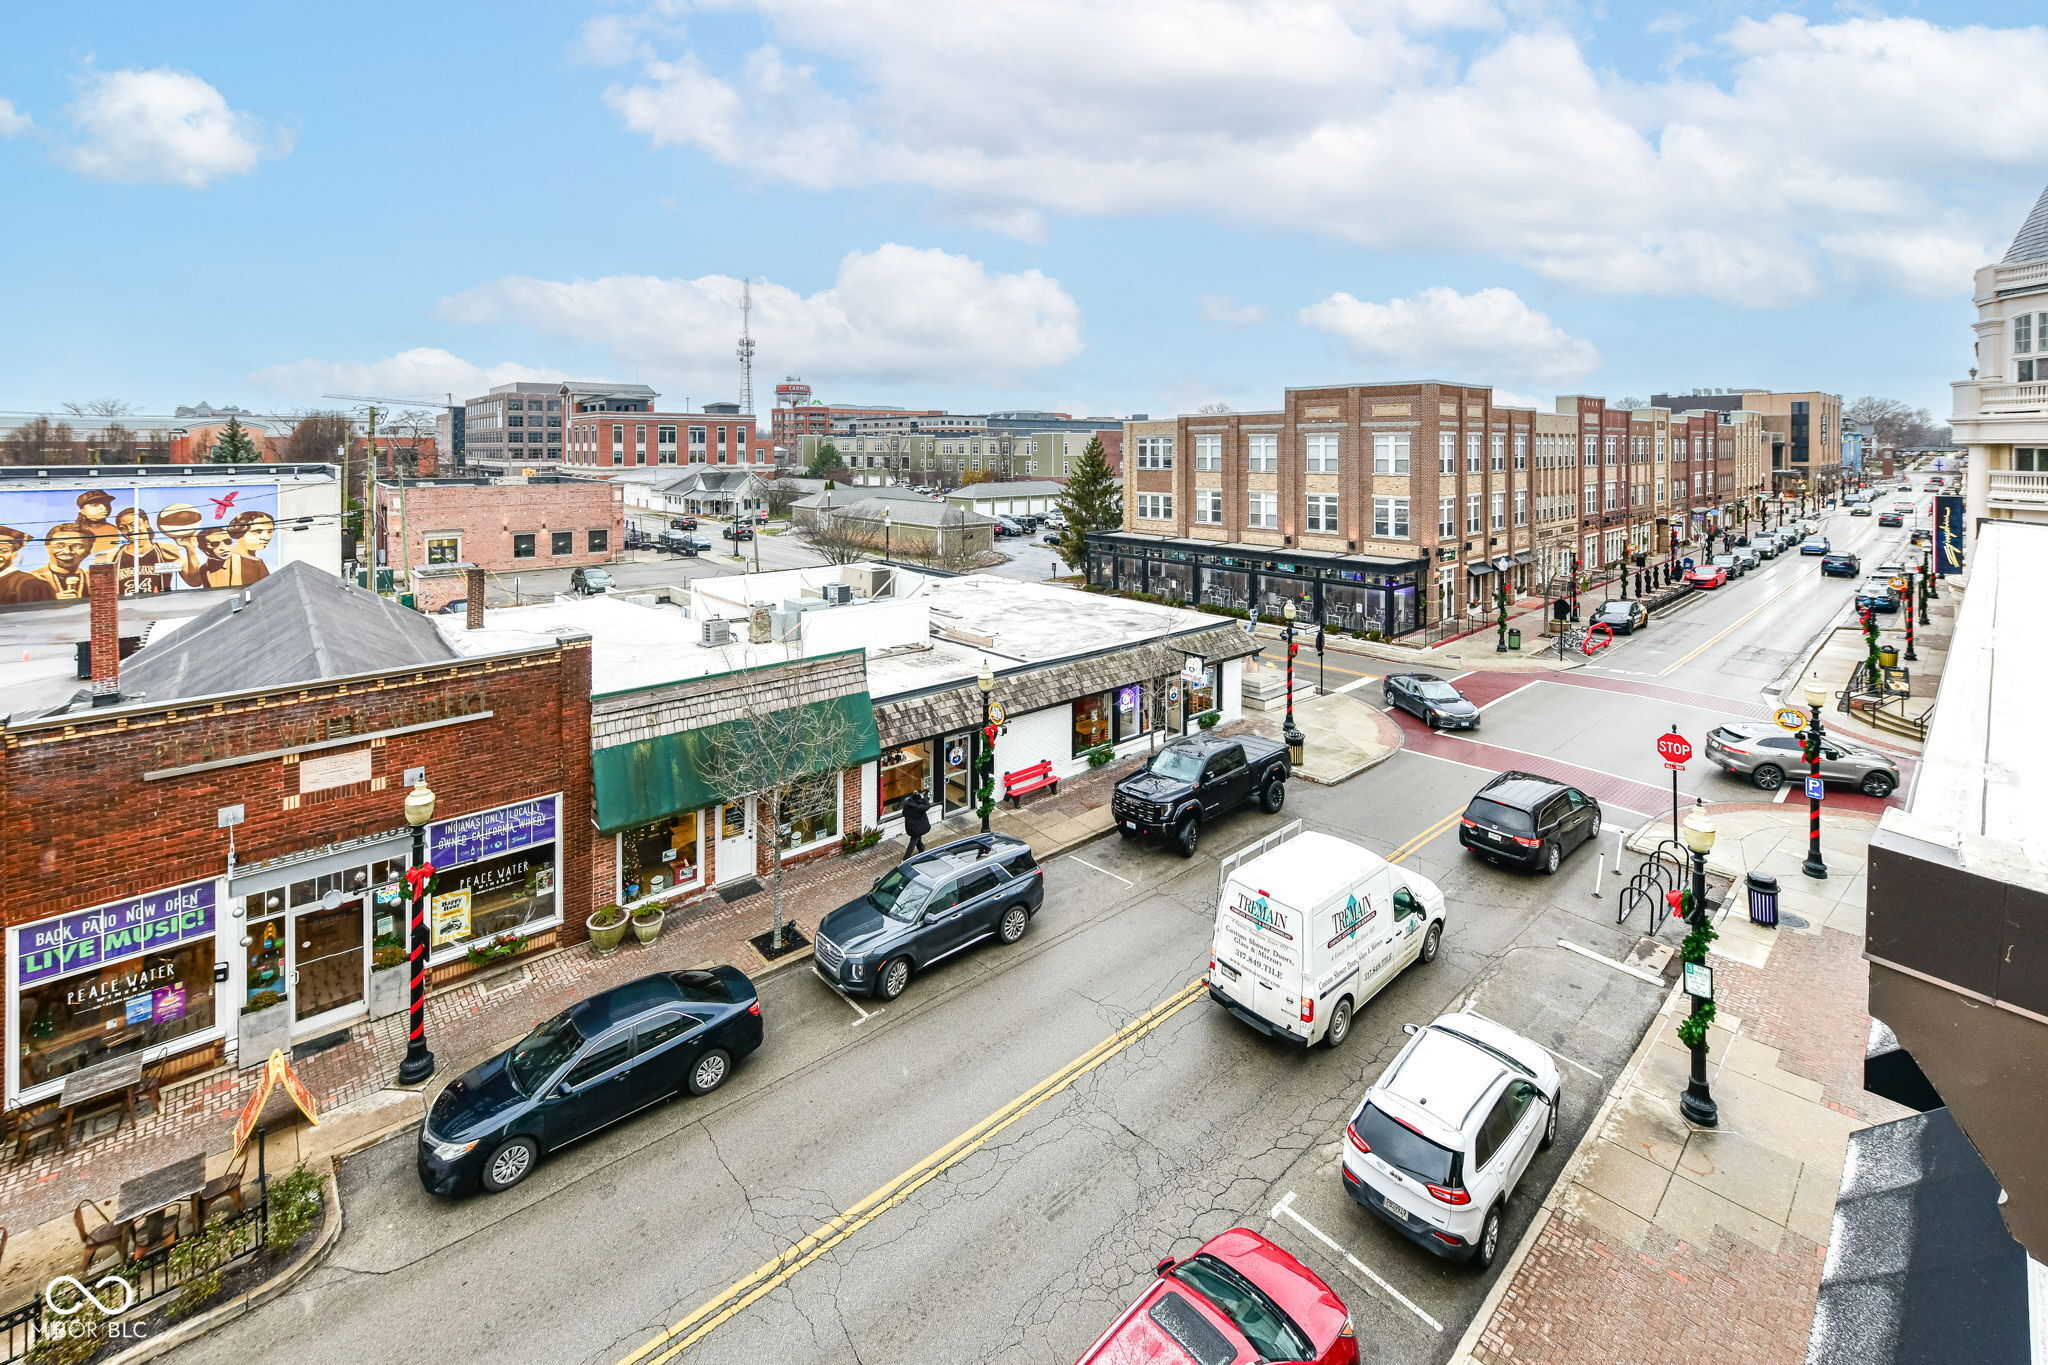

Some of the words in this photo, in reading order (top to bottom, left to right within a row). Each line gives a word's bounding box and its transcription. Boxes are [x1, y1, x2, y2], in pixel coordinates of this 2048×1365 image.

[1659, 740, 1690, 756] STOP
[1809, 779, 1820, 791] P
[445, 815, 480, 835] INDIANA'S
[485, 811, 505, 825] ONLY
[509, 801, 543, 821] LOCALLY
[438, 834, 467, 850] OWNED
[471, 823, 517, 841] CALIFORNIA
[459, 869, 493, 890] PEACE
[497, 861, 529, 879] WATER
[35, 924, 79, 947] BACK
[82, 914, 117, 935] PATIO
[126, 904, 156, 924] NOW
[165, 888, 202, 913] OPEN
[1237, 892, 1288, 930] TREMAIN
[1331, 892, 1373, 935] TREMAIN
[26, 939, 96, 974] LIVE
[104, 908, 205, 952] MUSIC!
[1225, 924, 1247, 941] Custom
[1248, 937, 1271, 953] Shower
[1272, 949, 1295, 966] Doors,
[1233, 936, 1249, 950] Glass
[1250, 946, 1256, 954] &
[1257, 949, 1283, 967] Mirrors
[1234, 948, 1283, 980] 317.849.TILE
[67, 977, 119, 1006] PEACE
[126, 963, 176, 988] WATER
